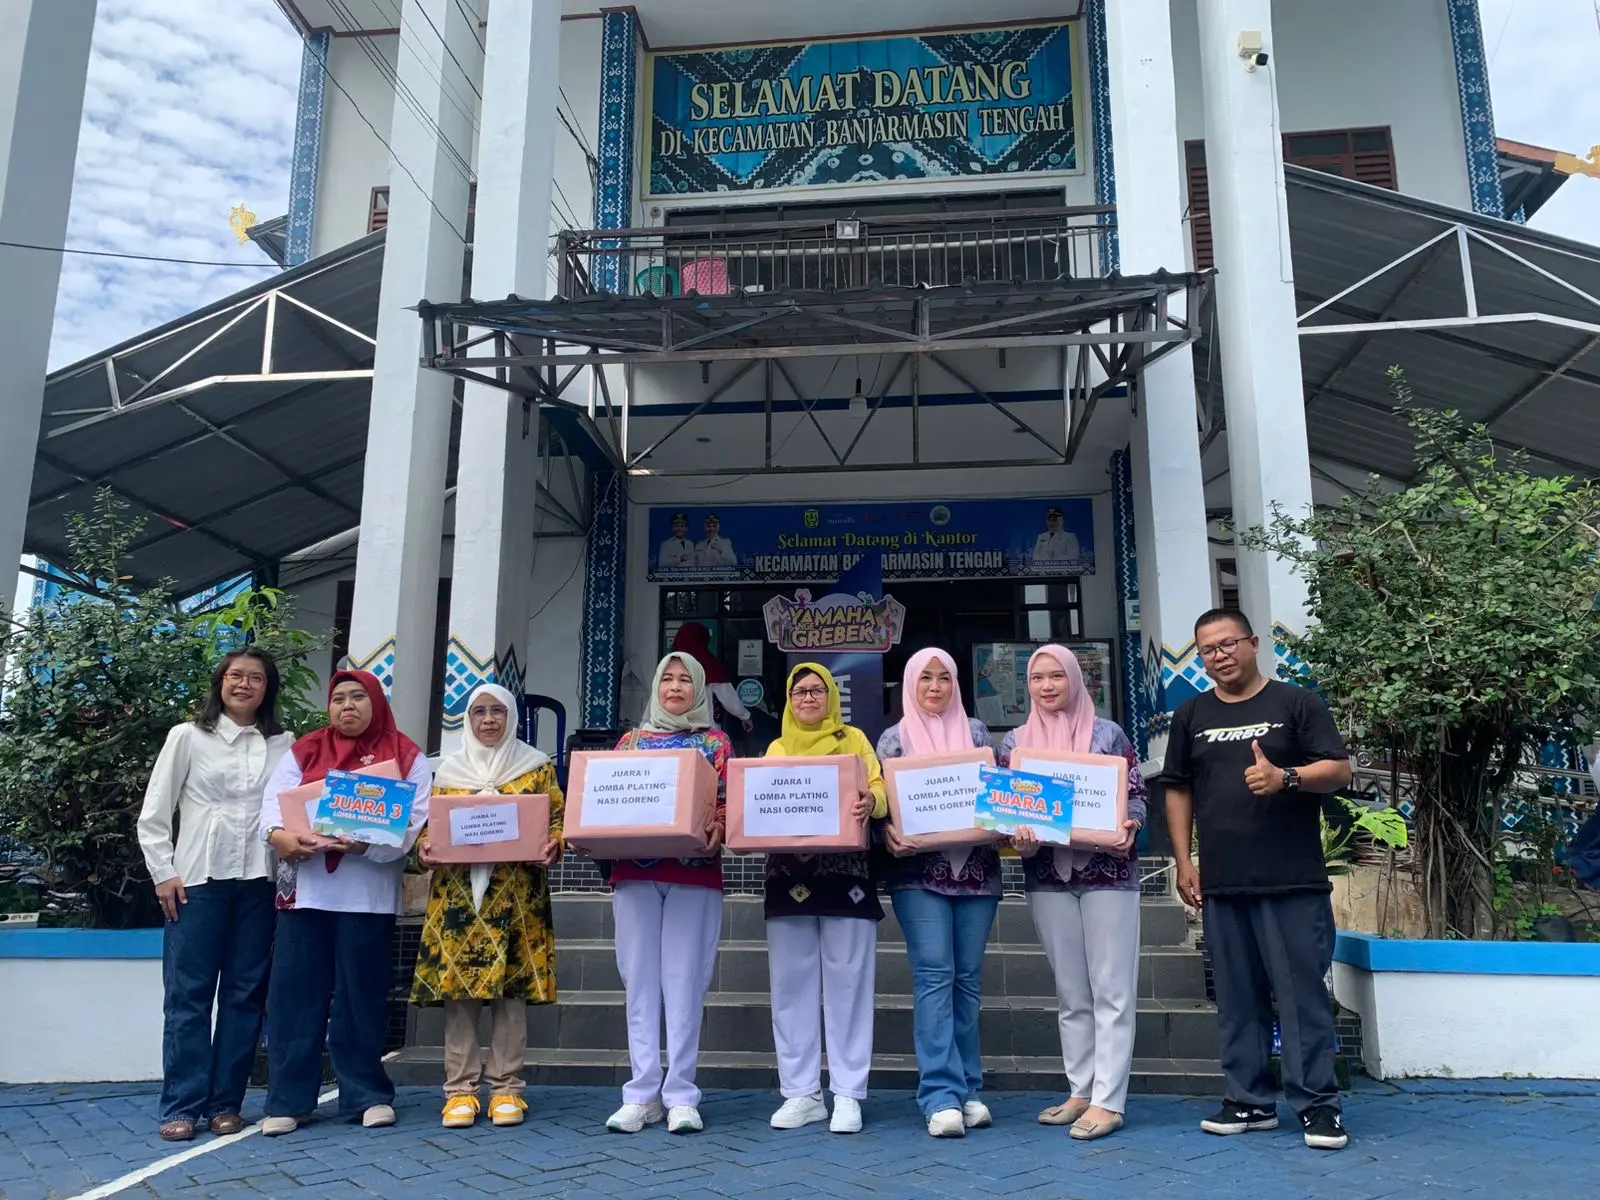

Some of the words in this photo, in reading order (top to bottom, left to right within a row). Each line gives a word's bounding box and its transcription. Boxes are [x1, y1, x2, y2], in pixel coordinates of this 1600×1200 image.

[690, 72, 861, 121] SELAMAT
[872, 60, 1032, 108] DATANG
[660, 129, 683, 156] DI
[692, 121, 814, 155] KECAMATAN
[826, 109, 968, 149] BANJARMASIN
[979, 104, 1064, 136] TENGAH
[777, 533, 837, 549] Selamat
[842, 532, 900, 550] Datang
[903, 530, 918, 545] di
[922, 530, 978, 546] Kantor
[755, 553, 839, 573] KECAMATAN
[950, 551, 1003, 569] TENGAH
[788, 606, 876, 626] YAMAHA
[792, 625, 874, 648] GREBEK
[1203, 722, 1271, 743] TURBO
[611, 770, 642, 778] JUARA
[644, 769, 651, 777] II
[627, 782, 667, 791] PLATING
[771, 778, 803, 786] JUARA
[924, 776, 955, 786] JUARA
[621, 796, 660, 804] GORENG
[754, 793, 787, 801] LOMBA
[789, 791, 829, 800] PLATING
[908, 792, 940, 801] LOMBA
[330, 794, 386, 816] JUARA
[389, 804, 402, 818] 3
[915, 804, 938, 813] NASI
[988, 789, 1047, 812] JUARA
[1052, 800, 1063, 816] 1
[759, 806, 782, 814] NASI
[784, 805, 824, 814] GORENG
[992, 806, 1017, 816] LOMBA
[333, 810, 357, 820] LOMBA
[357, 813, 390, 825] MEMASAK
